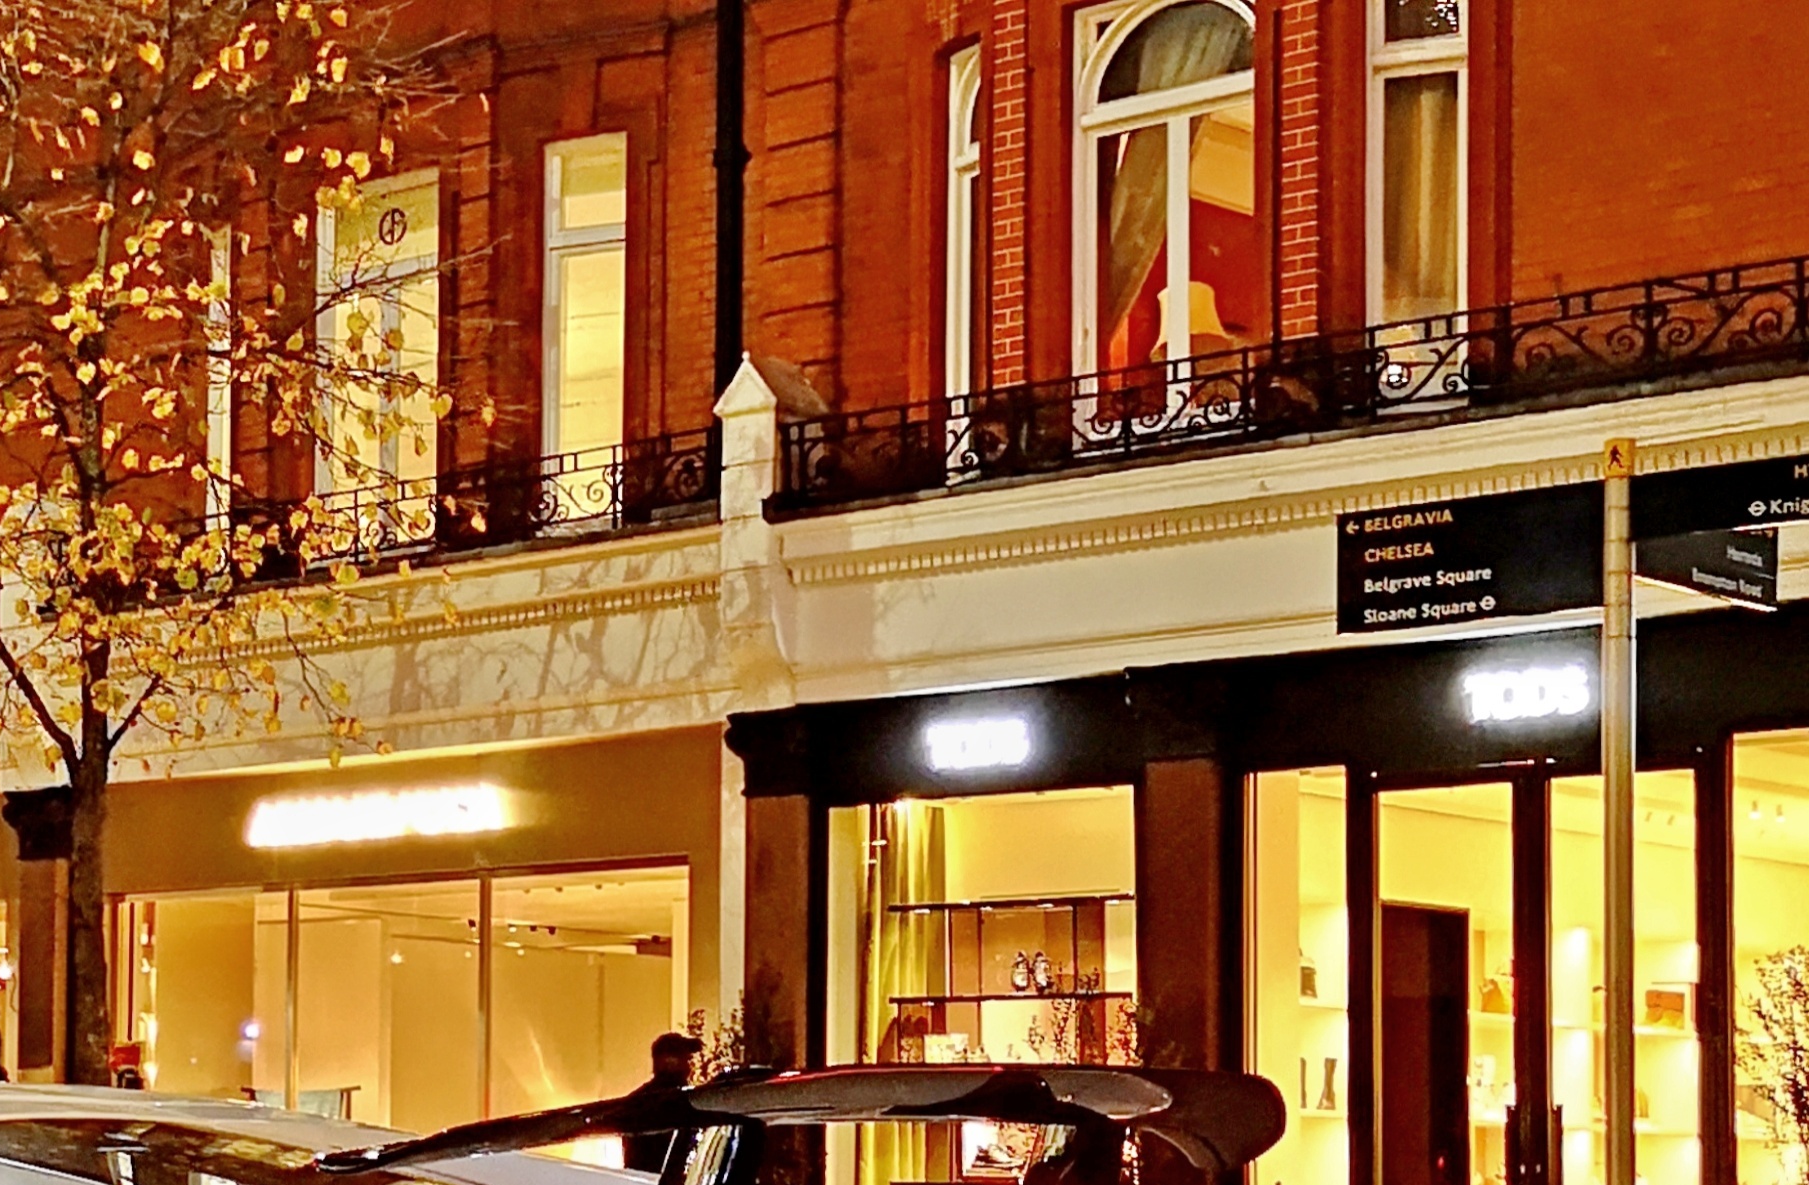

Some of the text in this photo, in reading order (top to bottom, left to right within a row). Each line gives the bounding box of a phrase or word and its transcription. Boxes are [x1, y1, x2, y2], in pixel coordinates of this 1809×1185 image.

[1364, 509, 1453, 532] BELGRAVIA
[1364, 542, 1434, 562] CHELSEA
[1364, 568, 1492, 594] Belgrave Square
[1364, 600, 1477, 624] Sloane Square
